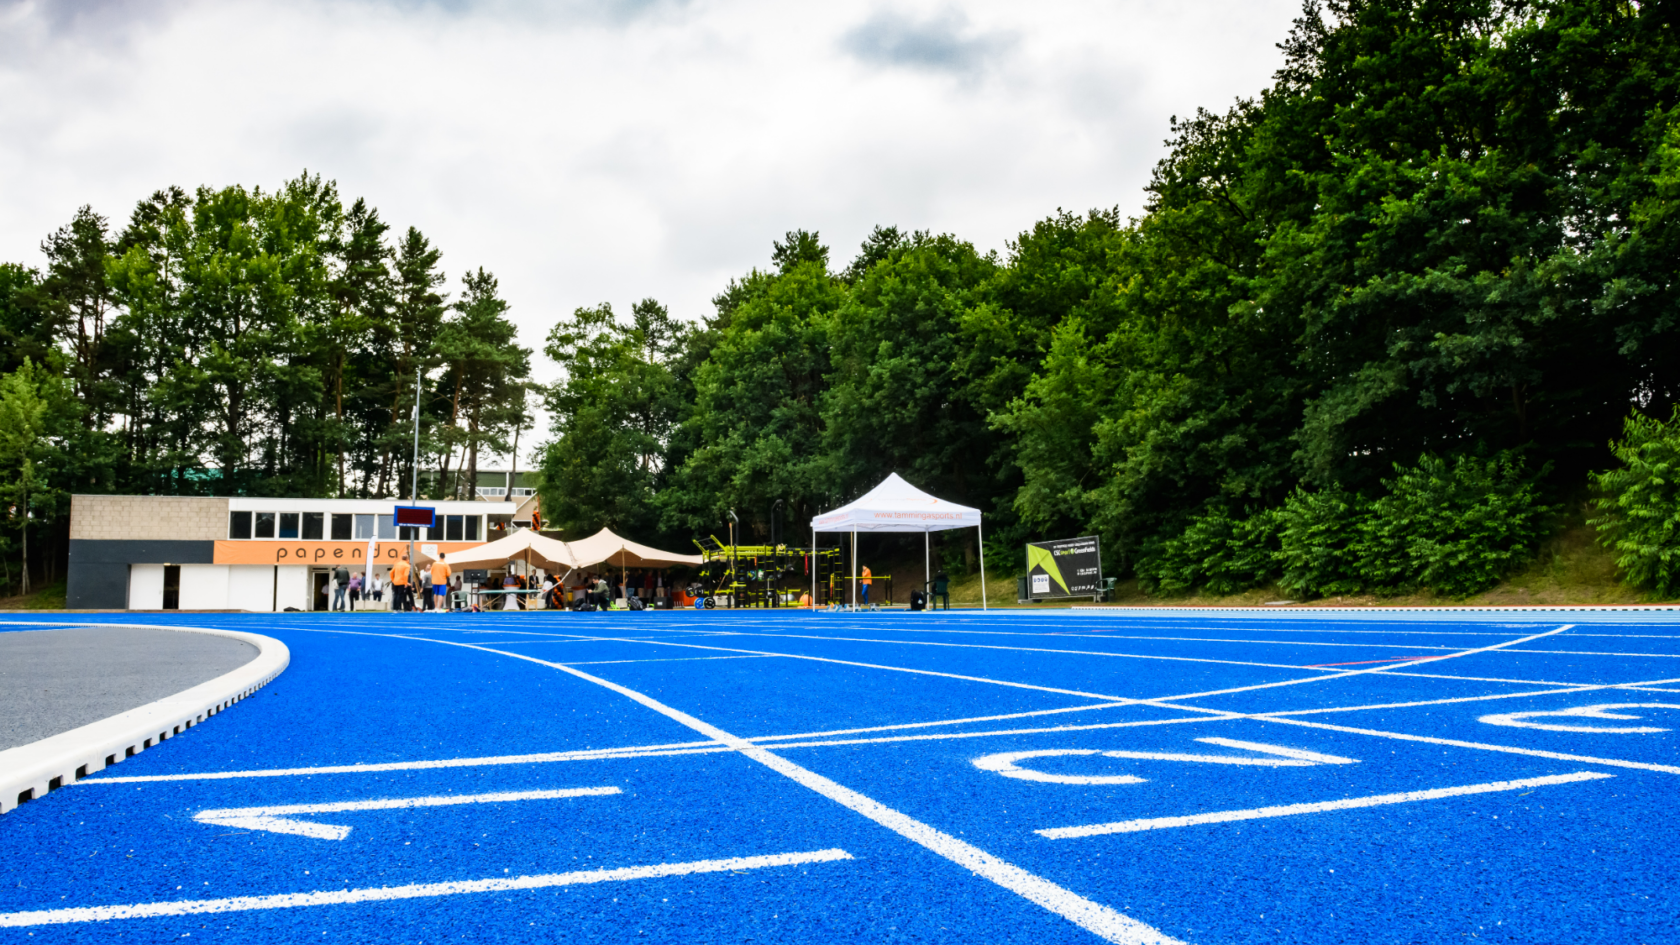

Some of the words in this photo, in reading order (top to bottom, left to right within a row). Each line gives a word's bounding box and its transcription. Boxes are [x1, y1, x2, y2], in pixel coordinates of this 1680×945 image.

[874, 511, 963, 521] www.tammingasports.nl
[972, 736, 1361, 785] 2
[192, 785, 622, 840] 1
